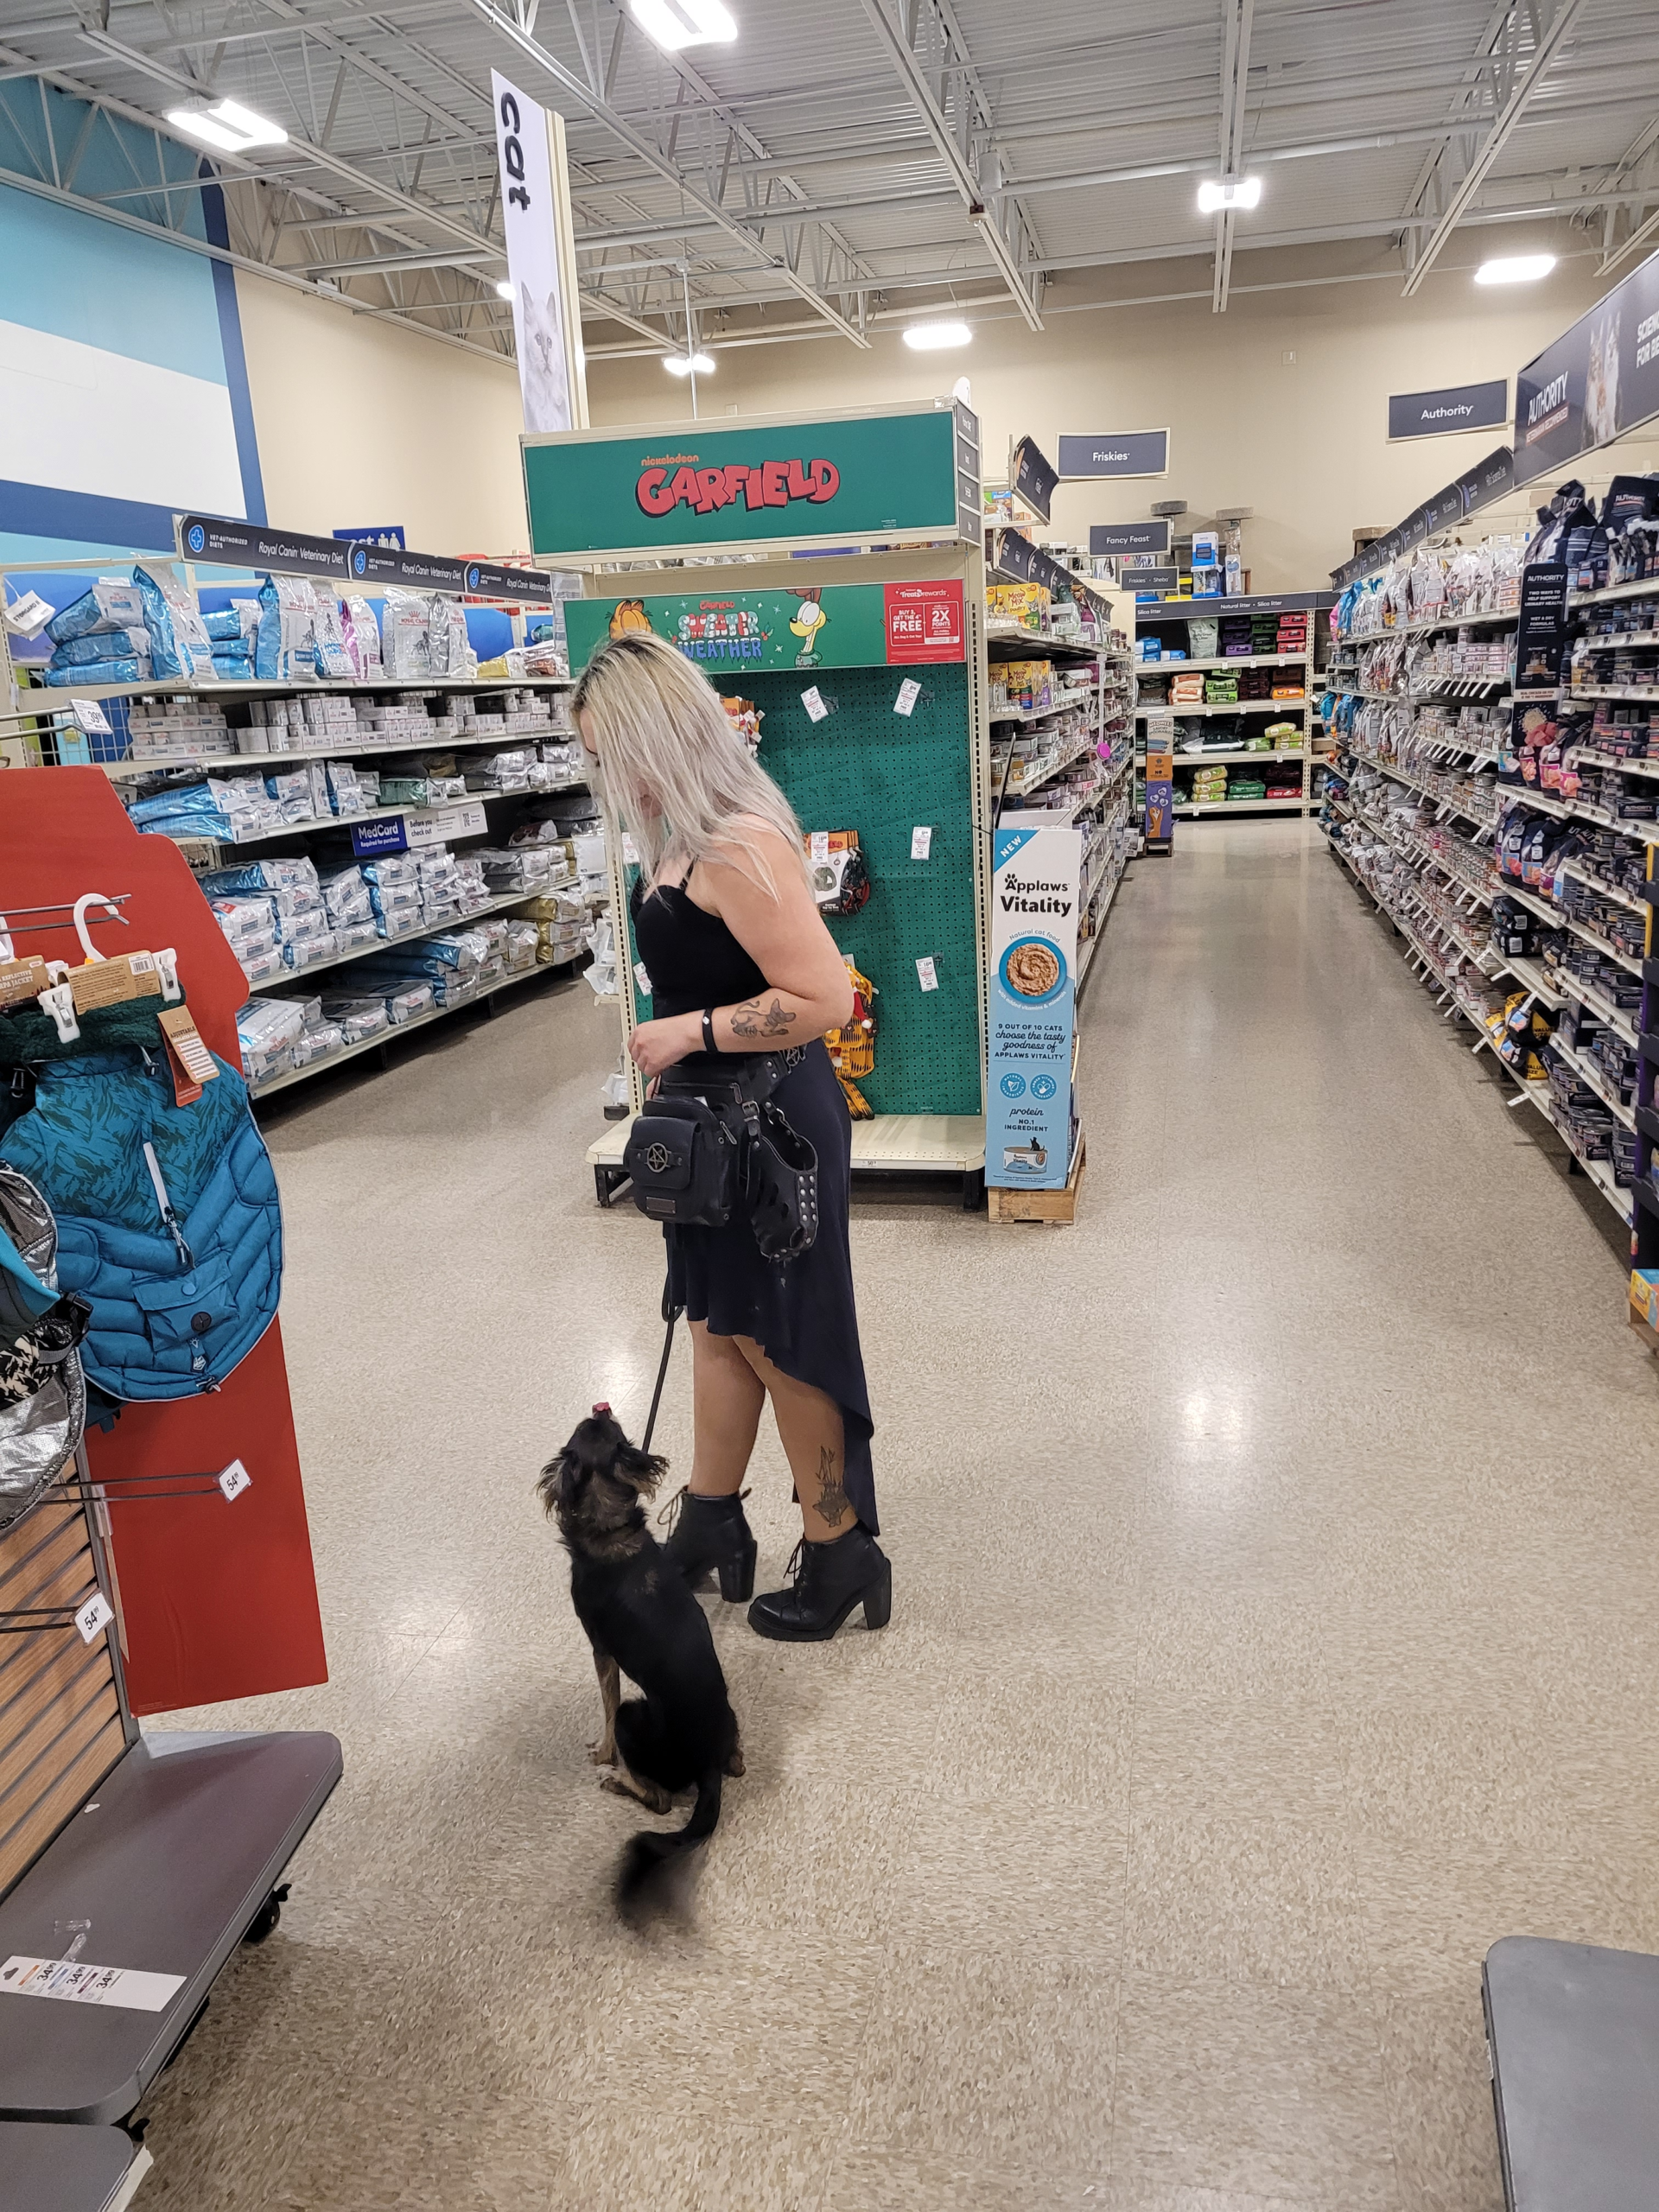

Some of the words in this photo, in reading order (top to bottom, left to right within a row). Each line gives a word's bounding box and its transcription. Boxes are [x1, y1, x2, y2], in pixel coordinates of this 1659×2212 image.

[501, 92, 531, 211] cat
[1528, 371, 1568, 426] AUTHORITY
[1421, 404, 1474, 420] Authority
[641, 454, 699, 467] nickelodeon
[1092, 451, 1128, 461] Friskies
[635, 459, 841, 518] GARFIELD
[209, 534, 248, 545] VET-AUTHORIZED
[1129, 535, 1150, 543] Feast
[259, 542, 277, 556] Royal
[278, 545, 297, 557] Canin
[300, 548, 331, 564] Veterinary
[332, 552, 344, 564] Diet
[402, 563, 415, 575] Royal
[416, 565, 429, 575] Canin
[430, 567, 452, 581] Veterinary
[453, 570, 461, 580] Diet
[1527, 574, 1565, 582] AUTHORITY
[506, 578, 518, 589] Royal
[1007, 588, 1027, 600] Meow
[931, 610, 950, 622] 2X
[678, 611, 760, 640] SWEATER
[893, 620, 922, 632] FREE
[677, 638, 762, 661] WEATHER
[358, 821, 398, 840] MedCard
[411, 828, 424, 837] check
[360, 839, 378, 848] Required
[383, 836, 400, 846] purchase
[1000, 835, 1022, 857] NEW
[1005, 876, 1069, 894] Applaws
[1000, 895, 1072, 918] Vitality
[1008, 929, 1033, 940] Natural
[1046, 931, 1061, 943] food
[2, 969, 33, 982] REFLECTIVE
[11, 976, 33, 988] JACKET
[997, 988, 1006, 1000] with
[1005, 998, 1020, 1008] added
[1048, 990, 1067, 1006] minerals
[995, 1029, 1027, 1039] choose
[1027, 1031, 1042, 1040] the
[1043, 1033, 1066, 1044] tasty
[1002, 1040, 1046, 1051] goodness
[1046, 1041, 1058, 1053] of
[1008, 1107, 1045, 1118] protein
